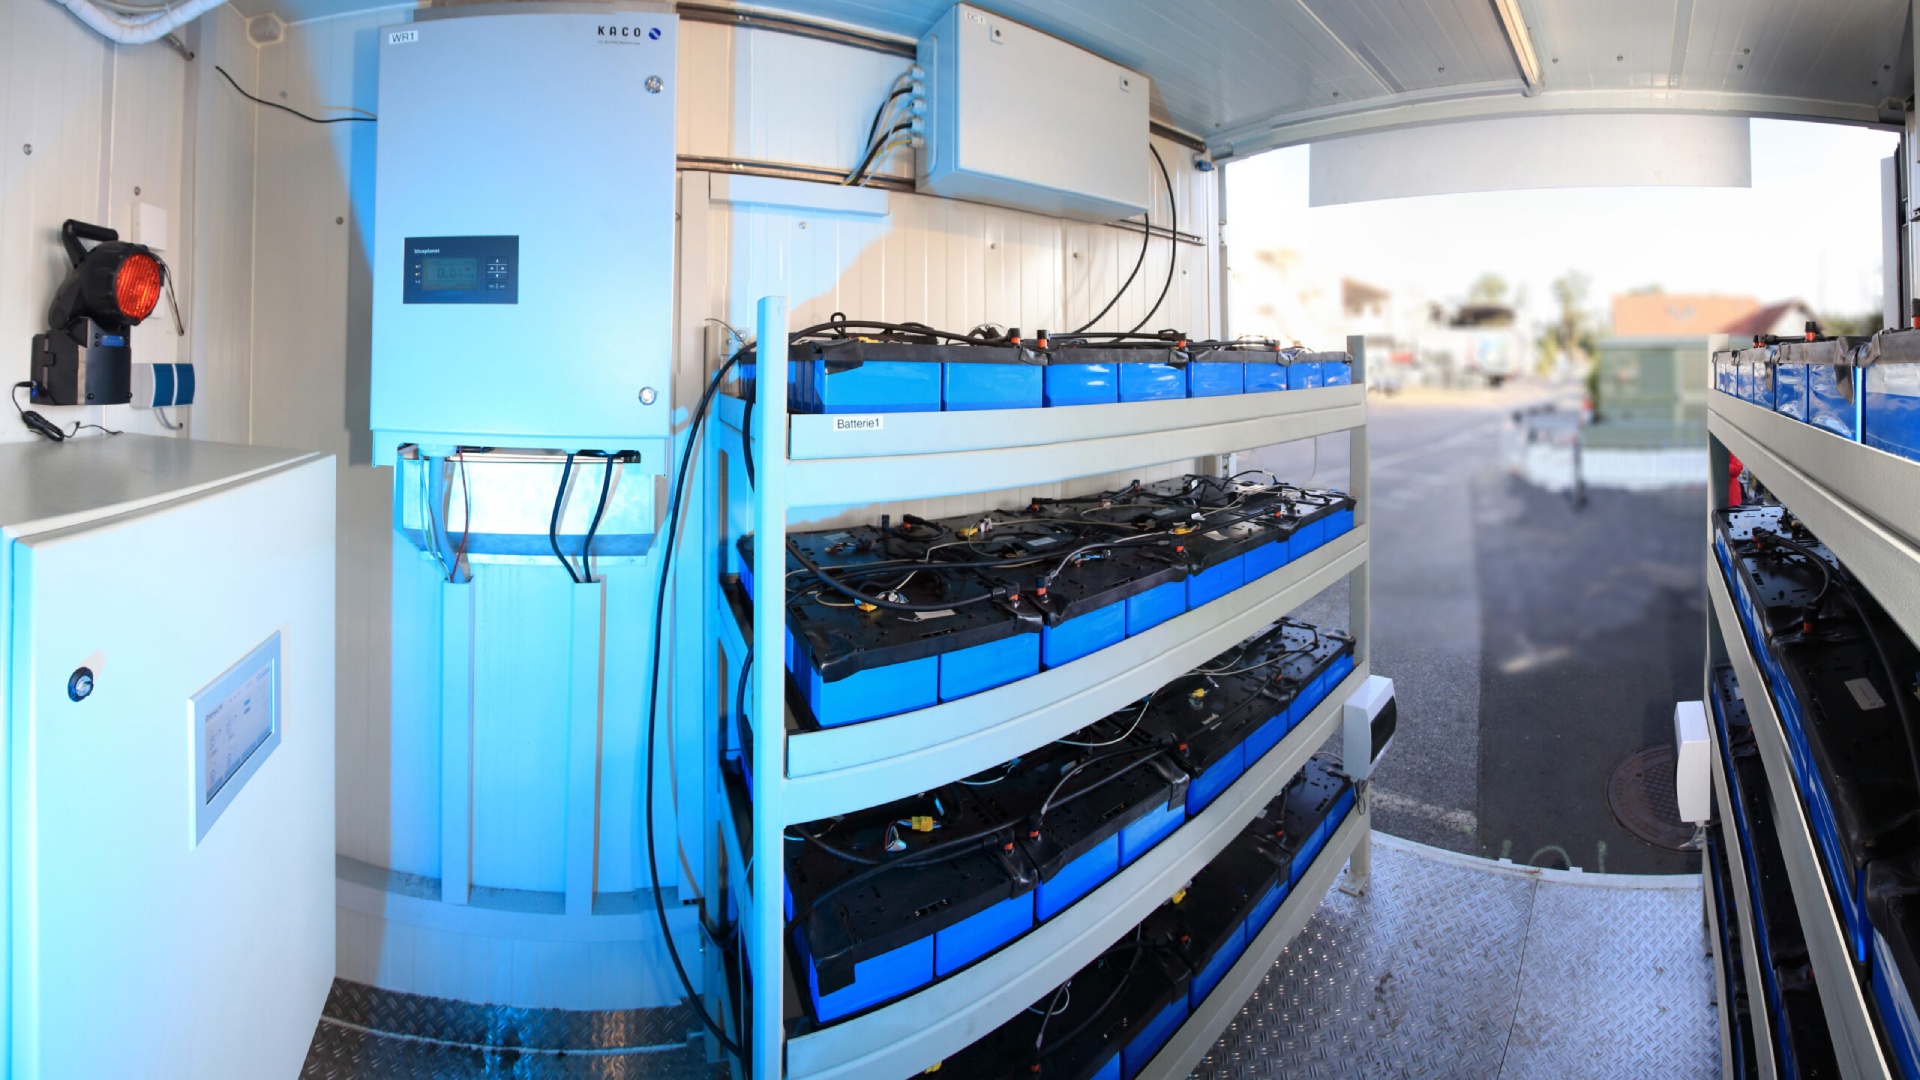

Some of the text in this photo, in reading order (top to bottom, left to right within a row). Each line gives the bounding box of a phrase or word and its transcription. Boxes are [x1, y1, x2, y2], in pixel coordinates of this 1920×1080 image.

[597, 25, 641, 38] KACO
[392, 32, 414, 43] WR1
[837, 418, 879, 429] Batterie1
